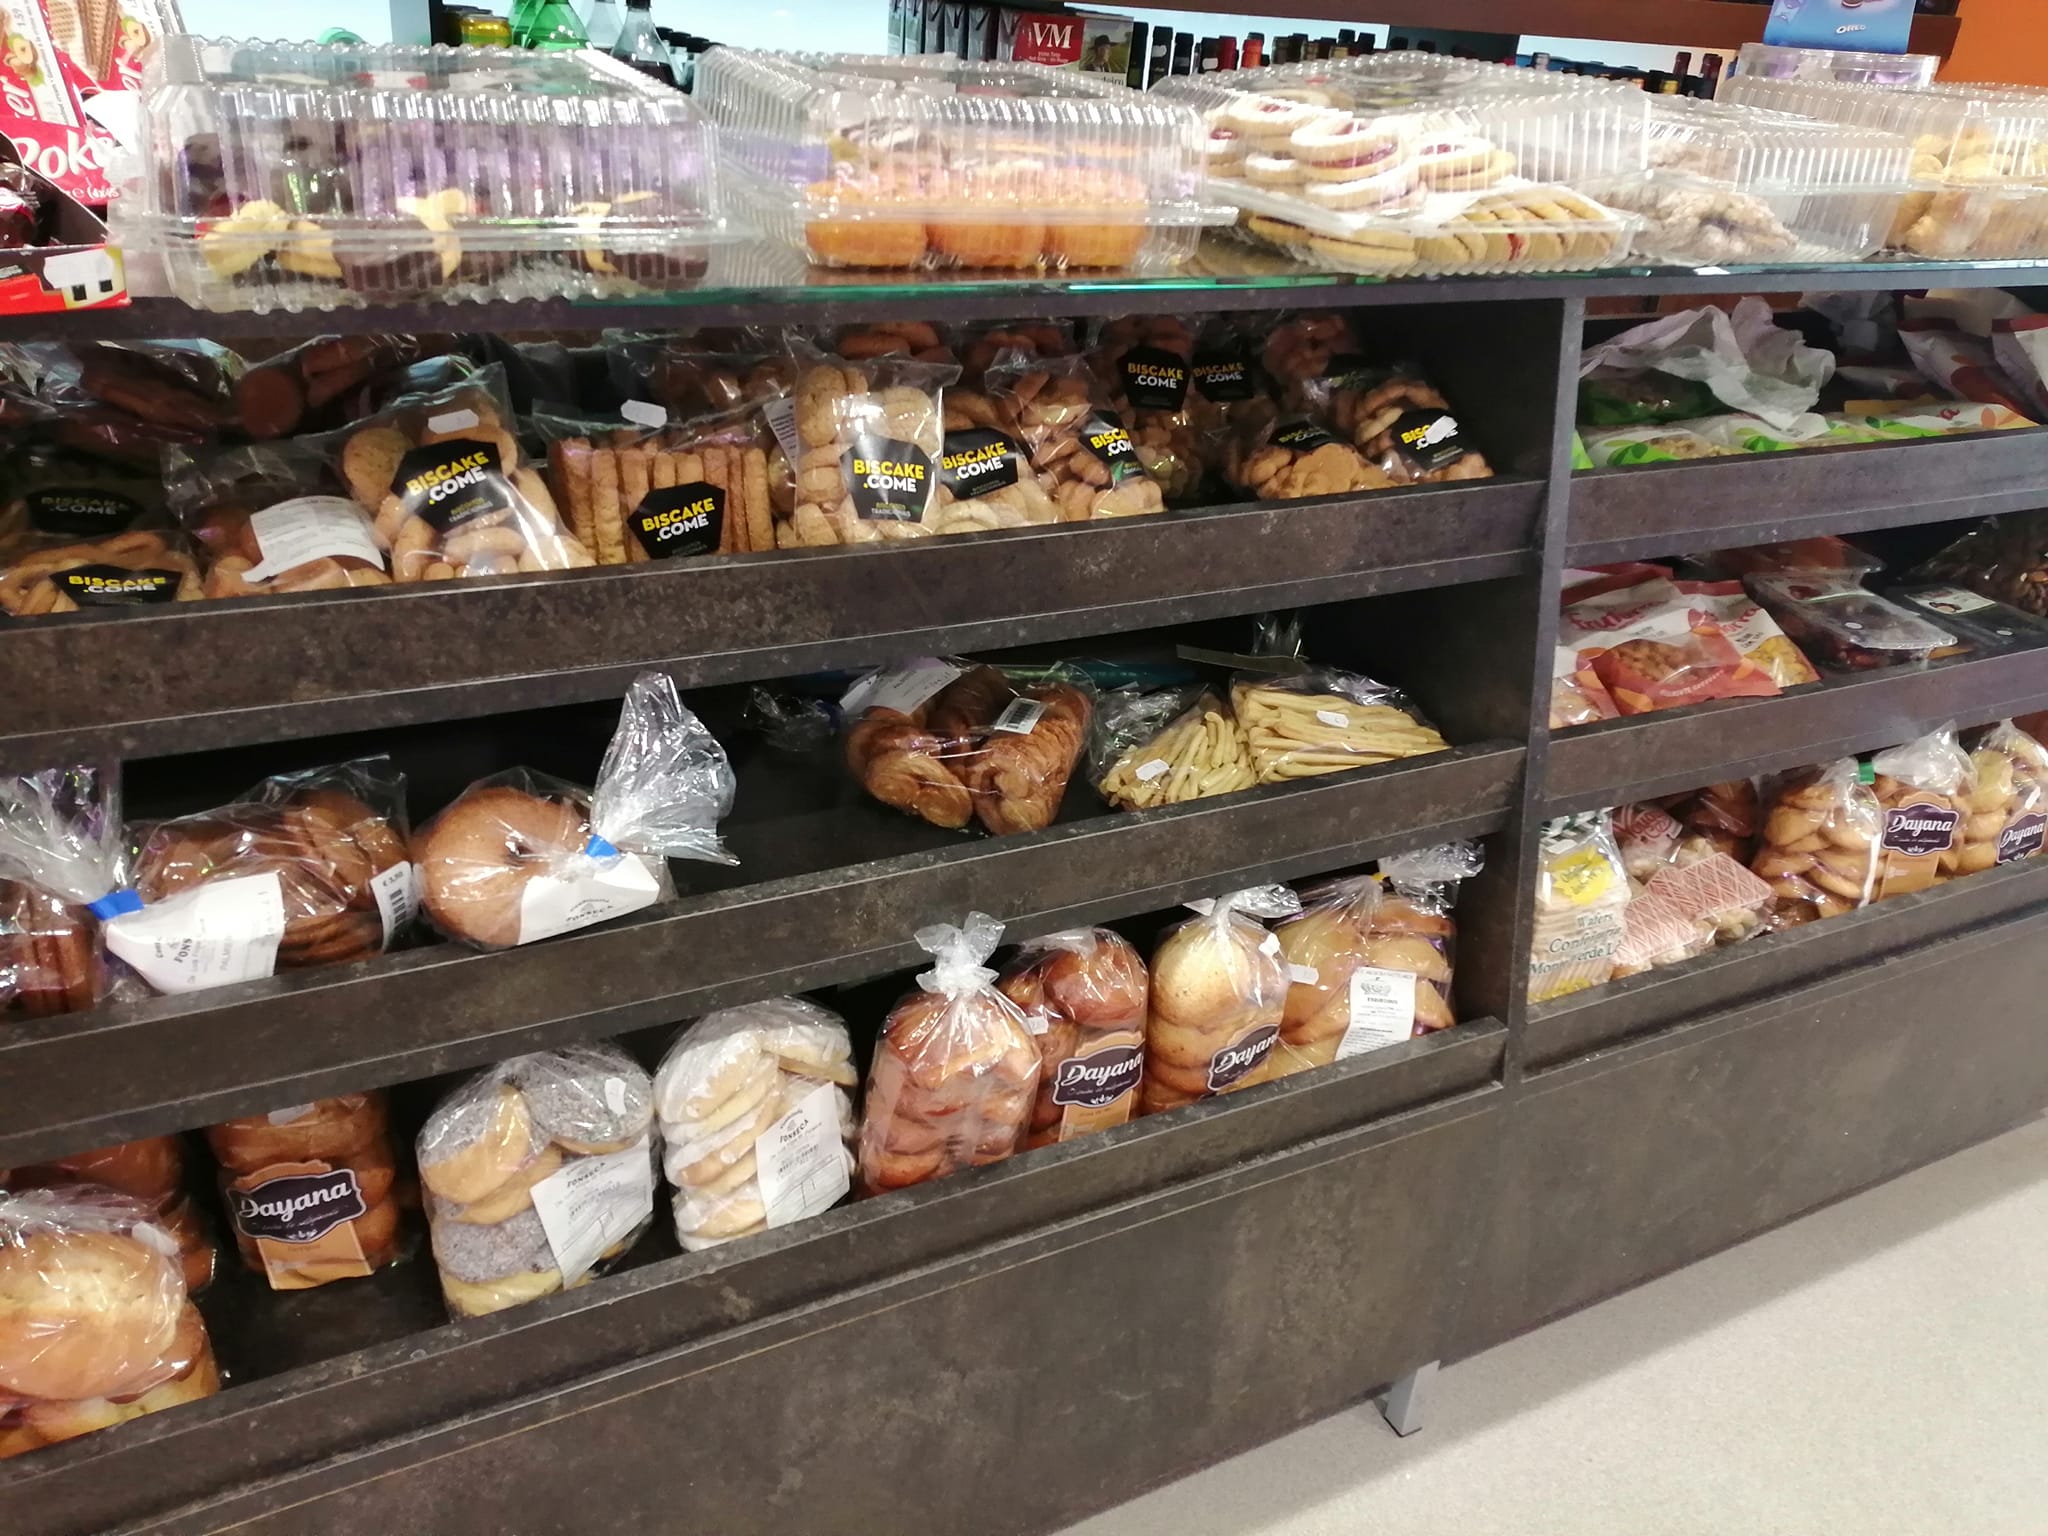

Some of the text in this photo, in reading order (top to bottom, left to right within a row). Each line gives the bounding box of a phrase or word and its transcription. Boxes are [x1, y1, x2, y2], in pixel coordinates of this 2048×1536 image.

[1033, 22, 1074, 49] VM
[1127, 362, 1184, 381] BISCAKE
[1135, 375, 1177, 389] .COME
[853, 459, 925, 480] BISCAKE
[942, 442, 1007, 470] BISCAKE
[956, 457, 1004, 480] .COME
[406, 451, 490, 496] BISCAKE
[429, 466, 487, 505] .COME
[863, 475, 917, 493] .COME
[642, 497, 715, 532] BISCAKE
[656, 513, 709, 542] .COME
[68, 575, 167, 587] BISCAKE
[83, 583, 158, 594] .COME
[1888, 814, 1953, 838] Dayana
[2000, 822, 2045, 849] Dayana
[1060, 1052, 1145, 1087] Dayana
[239, 1183, 353, 1223] Dayana
